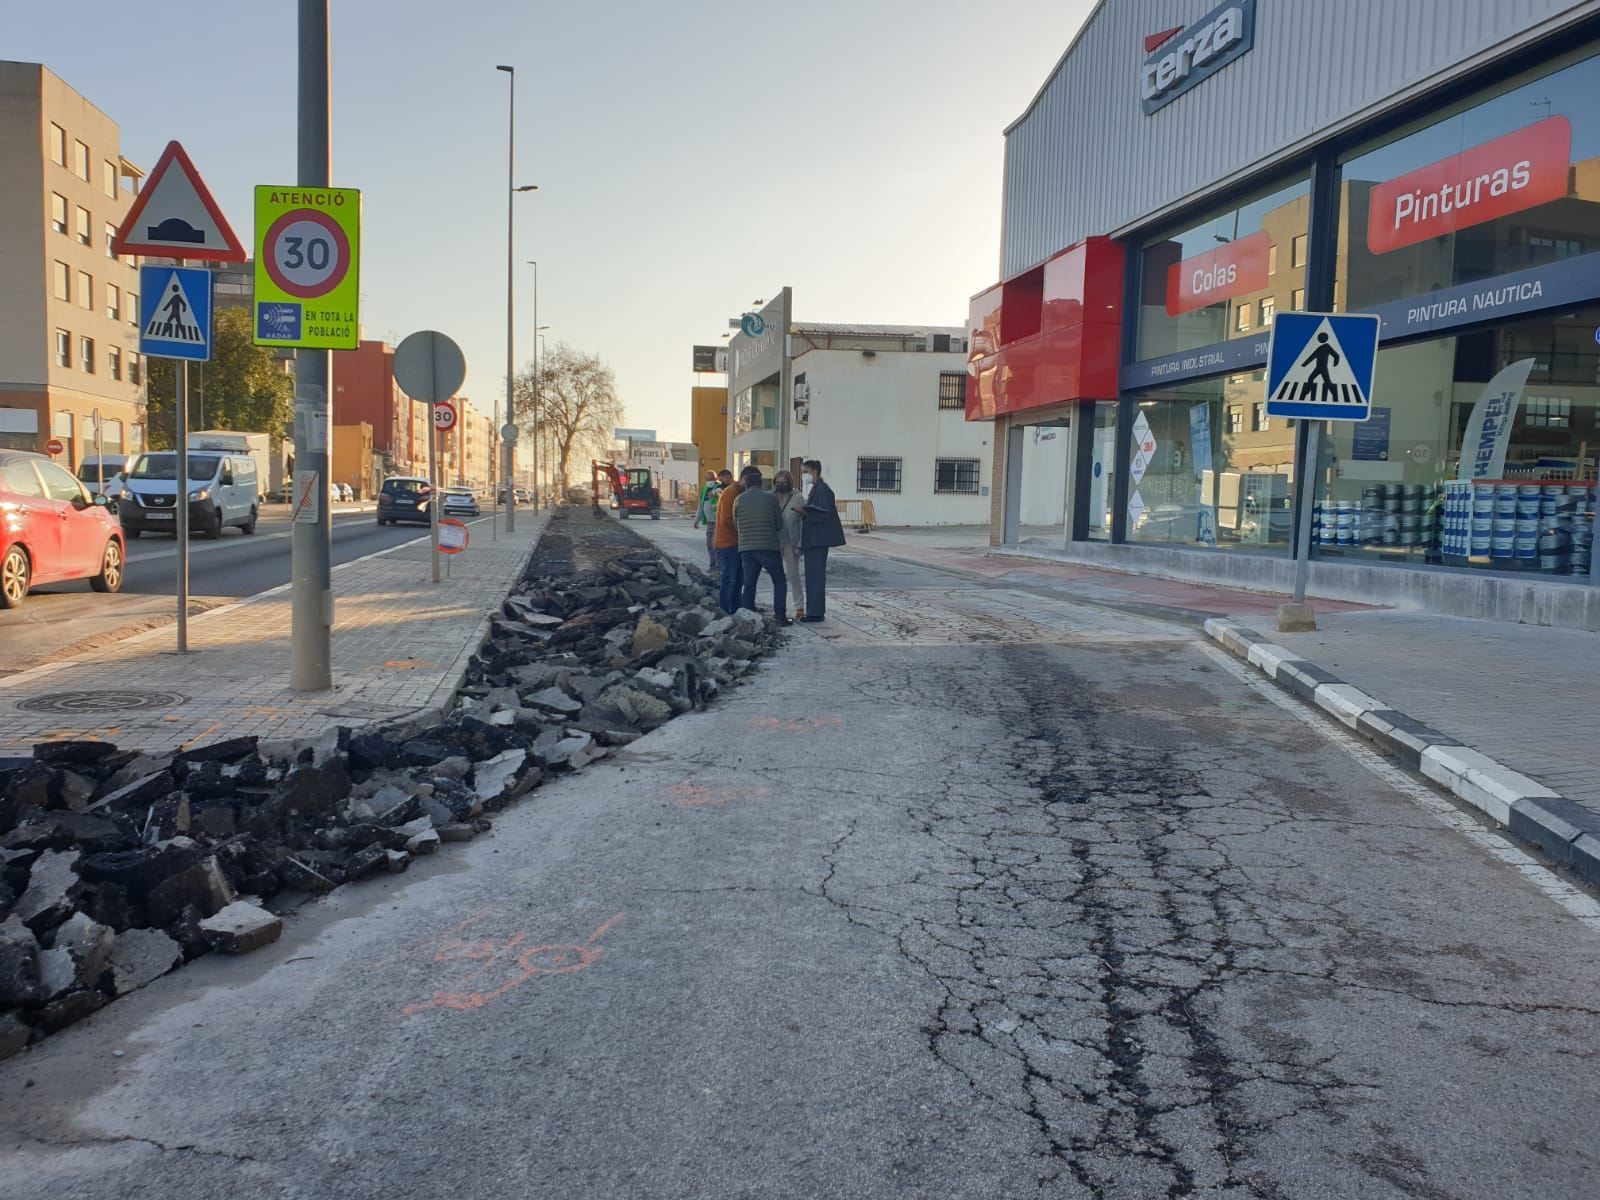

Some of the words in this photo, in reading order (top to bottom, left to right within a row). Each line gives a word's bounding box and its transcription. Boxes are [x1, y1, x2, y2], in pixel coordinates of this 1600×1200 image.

[269, 191, 345, 206] ATENCIÓ
[1394, 160, 1530, 230] Pinturas
[283, 236, 330, 270] 30
[1192, 263, 1237, 295] Colas
[1407, 298, 1467, 325] PINTURA
[1472, 280, 1543, 311] NAUTICA
[305, 310, 317, 321] EN
[320, 311, 341, 322] TOTA
[343, 312, 355, 323] LA
[308, 325, 351, 338] POBLACIÓ
[1151, 361, 1181, 377] PINTURA
[435, 411, 452, 422] 30
[1473, 398, 1502, 477] HEMPEL
[1143, 441, 1153, 453] 3M
